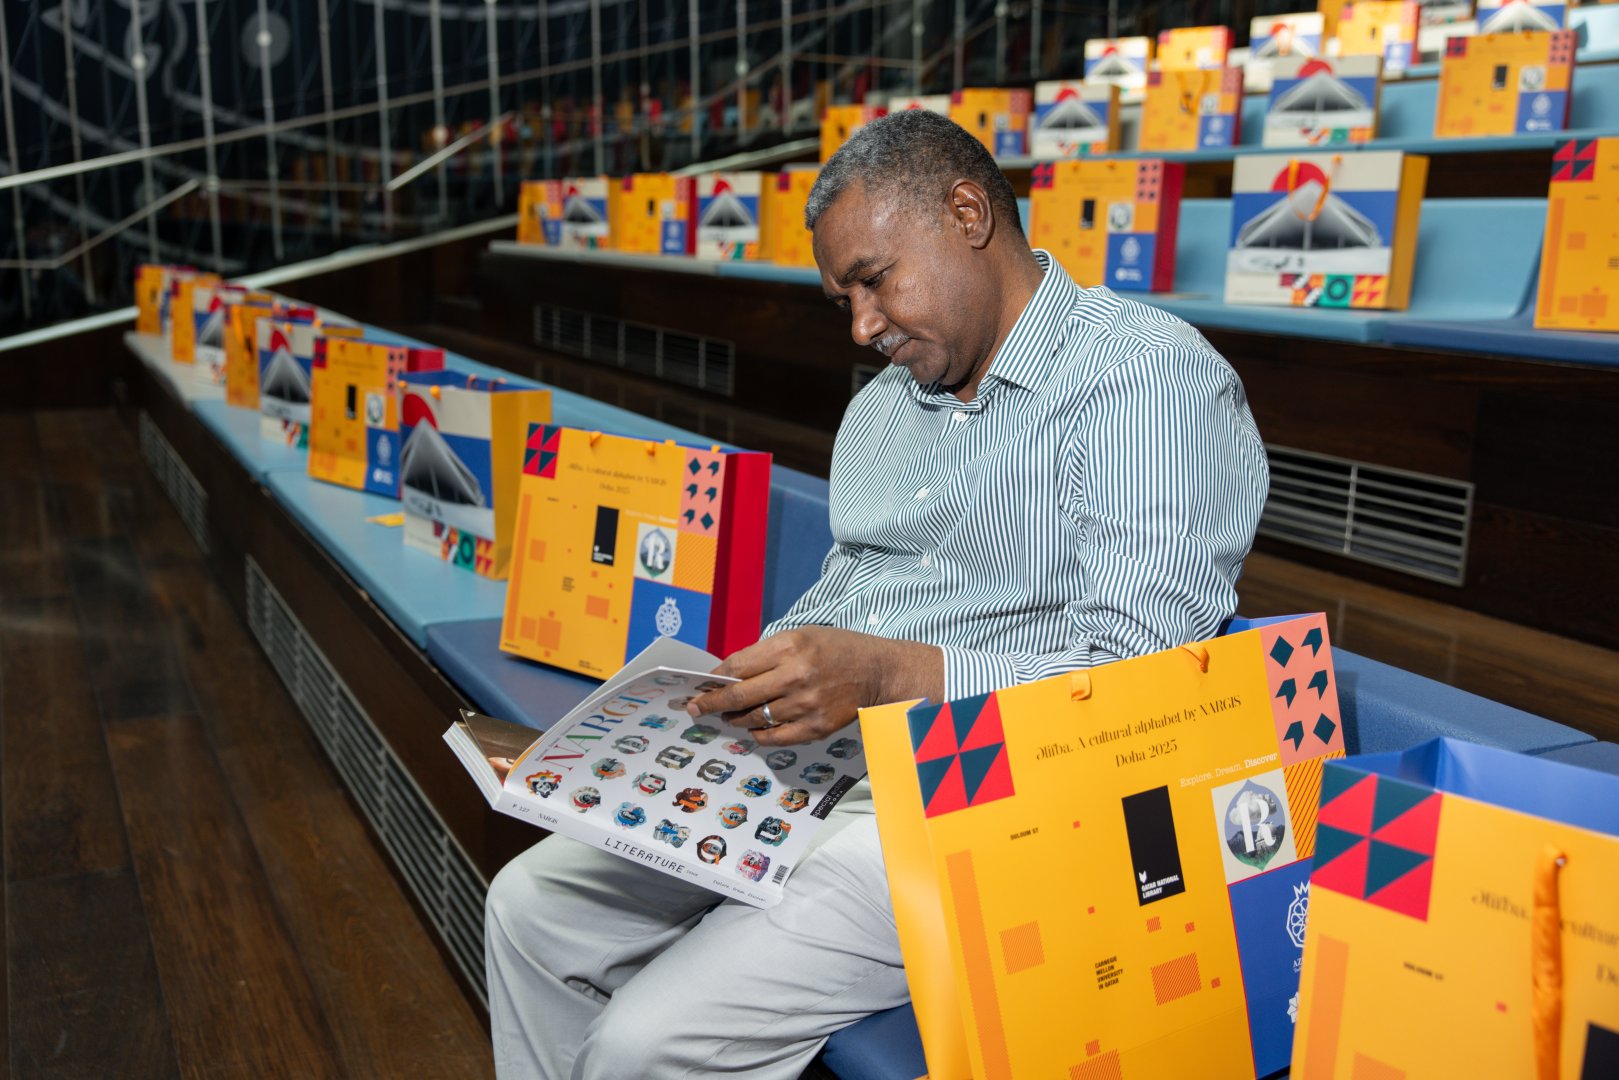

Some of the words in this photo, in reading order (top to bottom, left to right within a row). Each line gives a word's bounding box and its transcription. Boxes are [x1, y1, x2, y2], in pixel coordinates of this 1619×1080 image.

[540, 685, 666, 772] NARGIS
[1088, 723, 1132, 746] cultural
[1134, 711, 1182, 735] alphabet
[1183, 708, 1198, 721] by
[1199, 695, 1242, 718] NARGIS
[1115, 750, 1146, 768] Doha
[1148, 738, 1178, 759] 2025
[1244, 752, 1278, 769] Discover
[604, 837, 685, 874] LITERATURE
